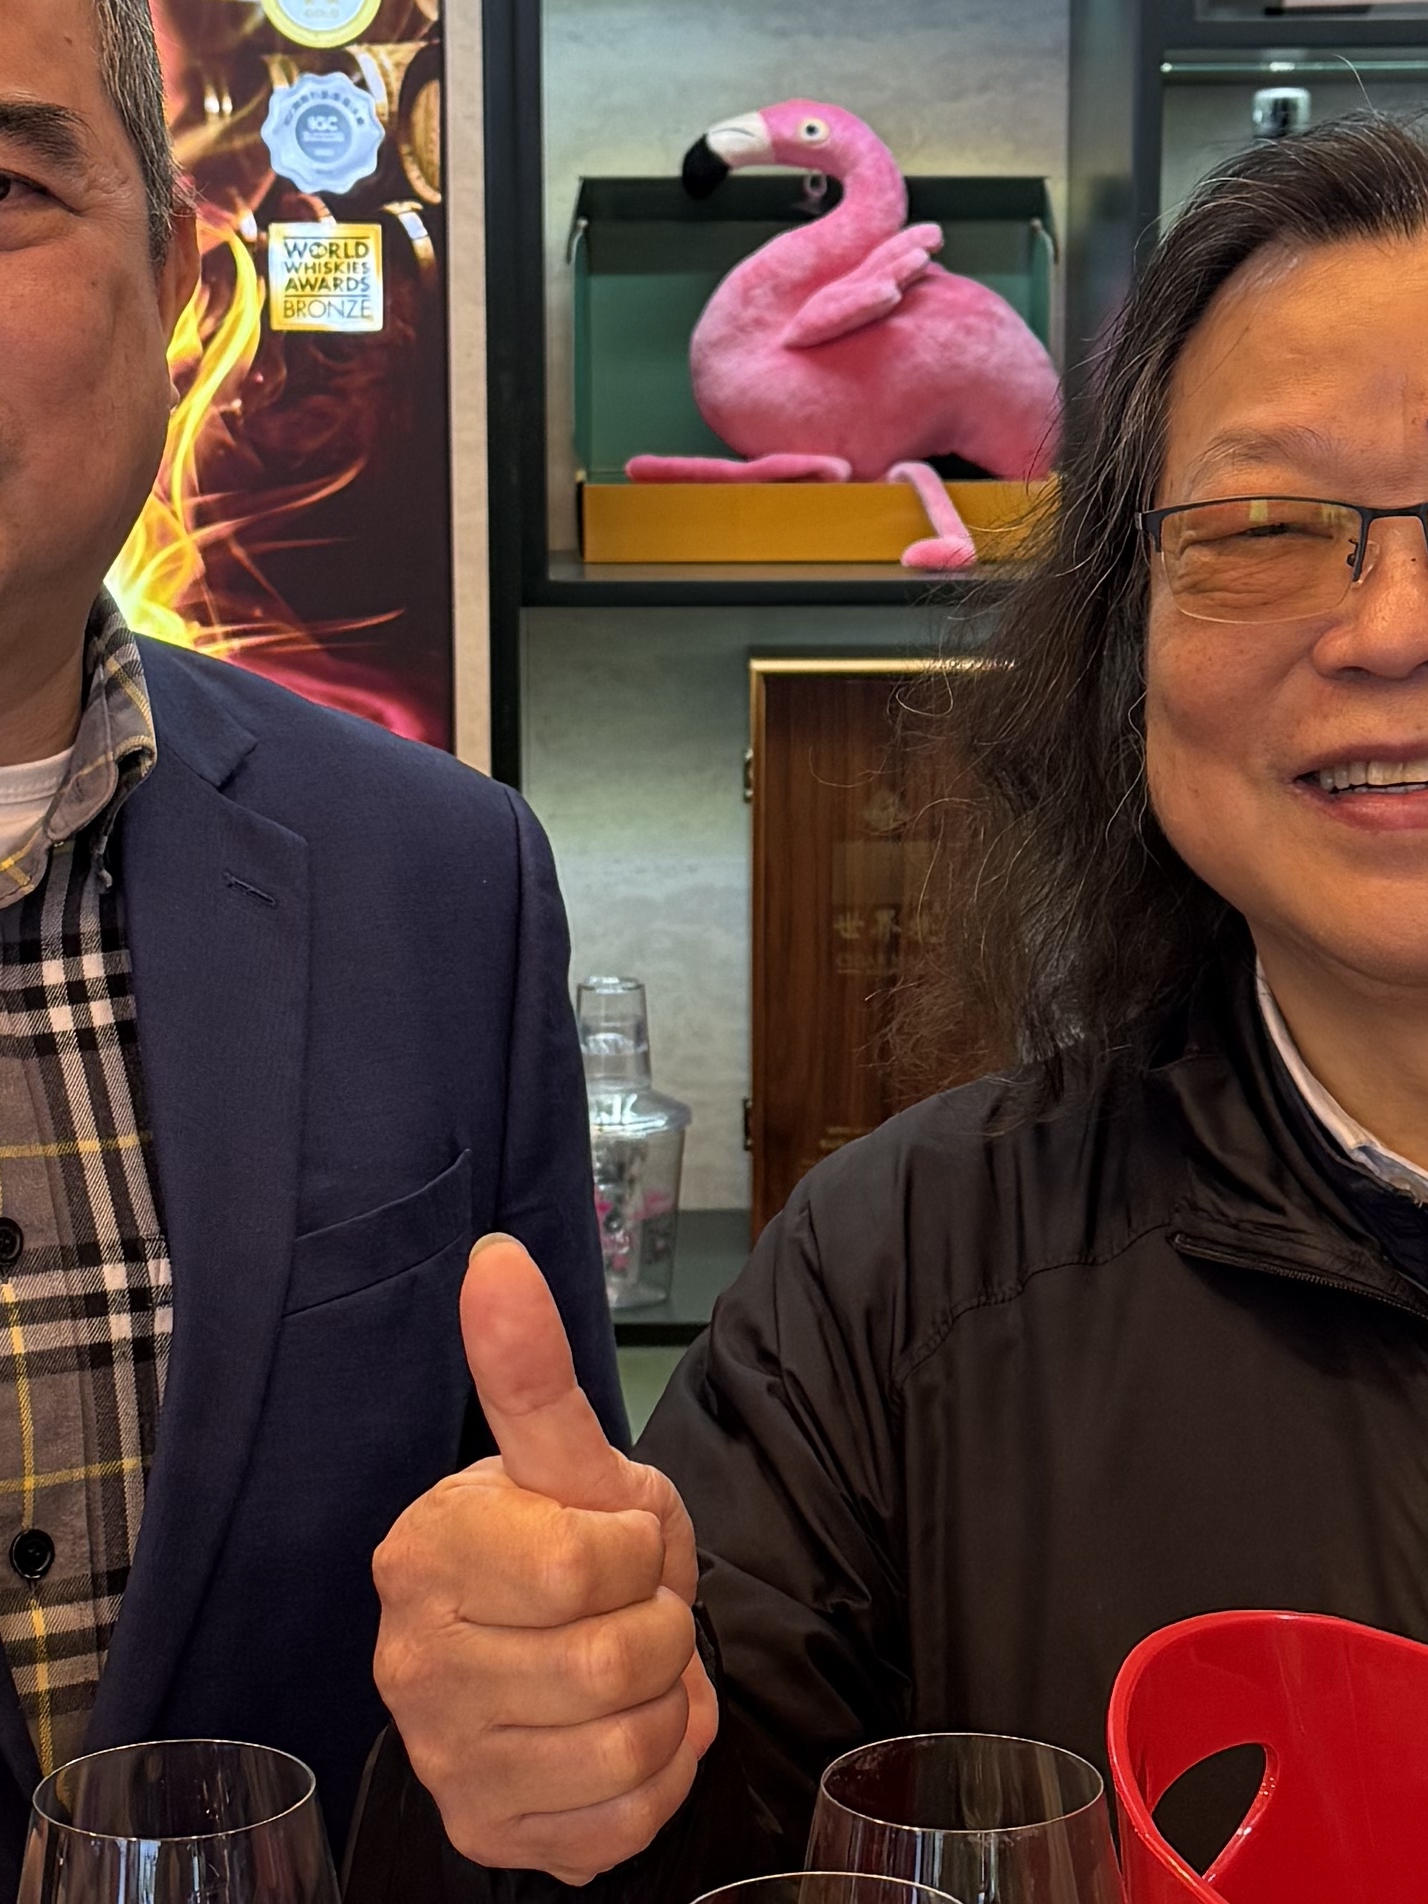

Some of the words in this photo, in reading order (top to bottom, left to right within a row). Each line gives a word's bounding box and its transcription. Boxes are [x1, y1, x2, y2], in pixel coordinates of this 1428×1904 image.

[284, 241, 370, 259] WORLD
[284, 261, 371, 275] WHISKIES
[284, 276, 371, 292] AWARDS
[283, 299, 374, 320] BRONZE
